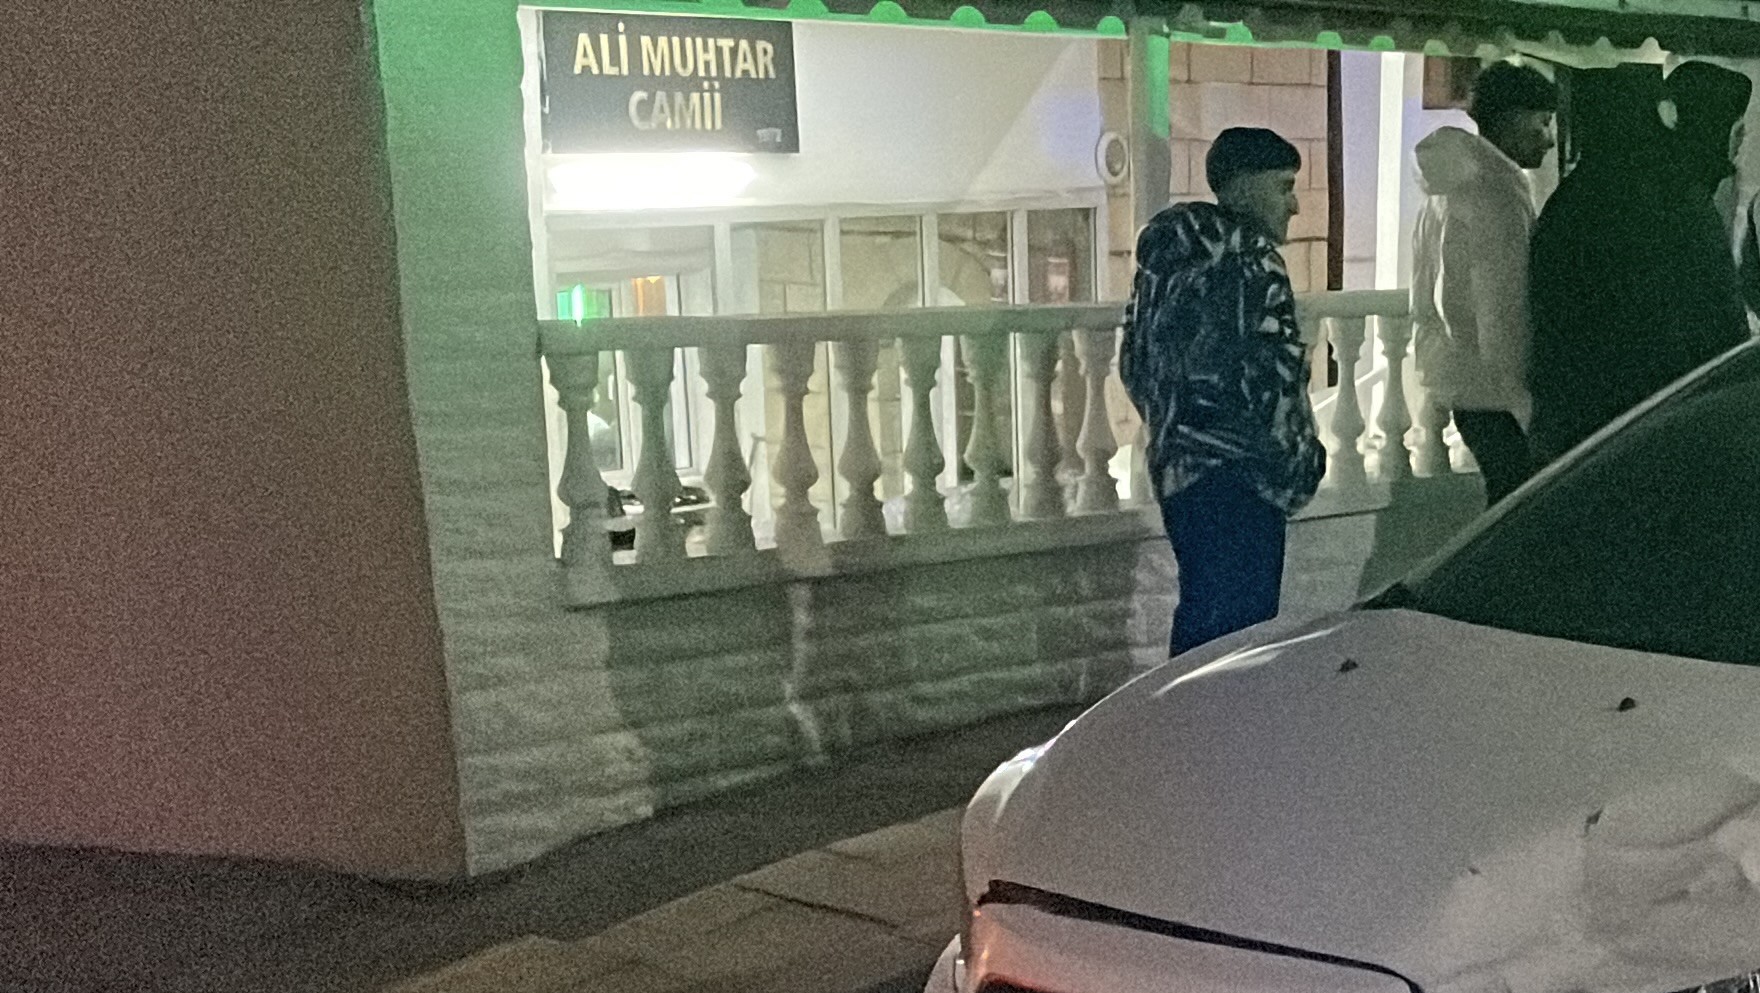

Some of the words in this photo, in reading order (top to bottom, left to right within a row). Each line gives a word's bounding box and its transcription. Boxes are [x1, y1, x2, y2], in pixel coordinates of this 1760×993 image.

[573, 21, 629, 76] ALİ
[640, 35, 776, 79] MUHTAR
[628, 81, 723, 131] CAMİİ
